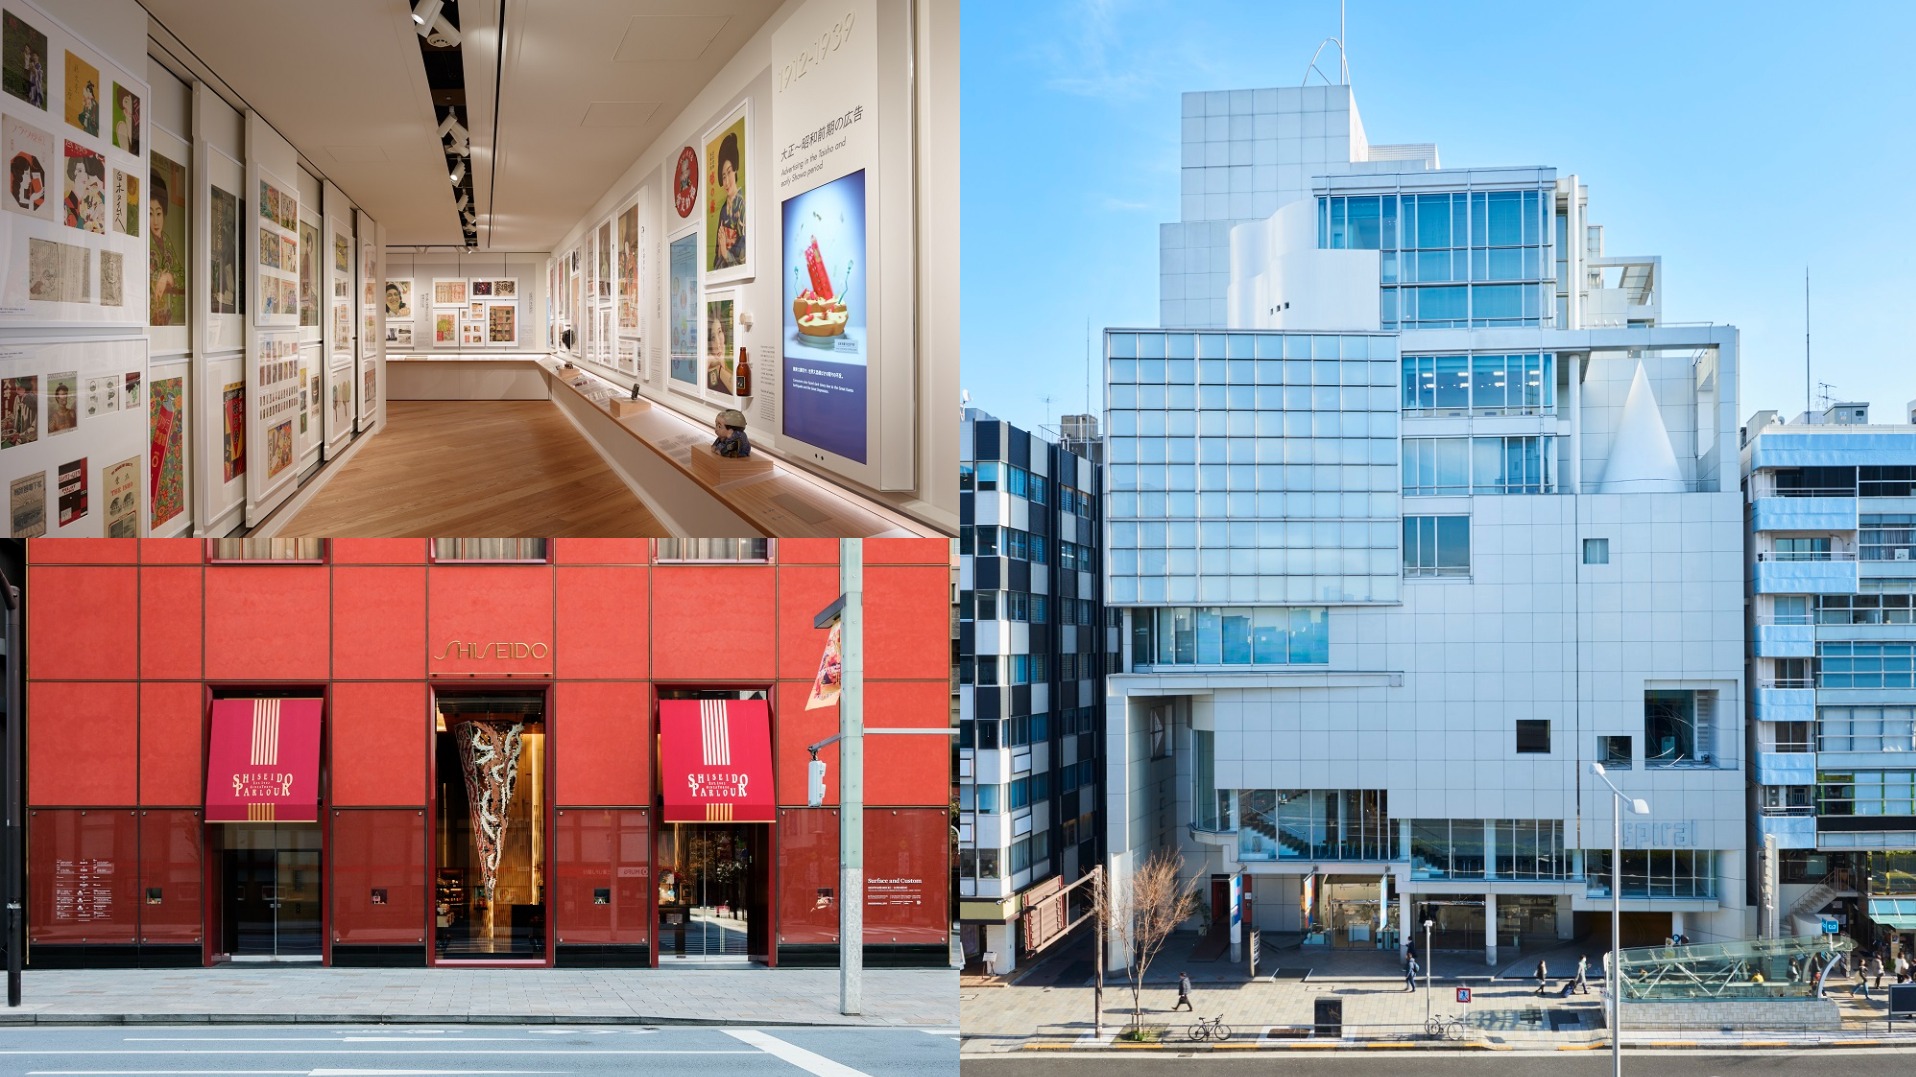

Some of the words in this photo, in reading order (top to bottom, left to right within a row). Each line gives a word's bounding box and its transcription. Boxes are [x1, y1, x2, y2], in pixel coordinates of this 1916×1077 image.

[779, 11, 855, 93] 1912-1939
[781, 161, 804, 176] Advertising
[810, 153, 818, 162] the
[835, 136, 847, 150] and
[780, 178, 791, 187] early
[791, 172, 806, 182] Showa
[807, 160, 823, 177] period
[434, 640, 548, 660] SHISEIDO
[232, 773, 293, 788] SHISEIDO
[234, 783, 290, 797] PARLOUR
[688, 773, 748, 788] SHISEIDO
[692, 783, 747, 797] PARLOUR
[1623, 819, 1697, 849] spiral
